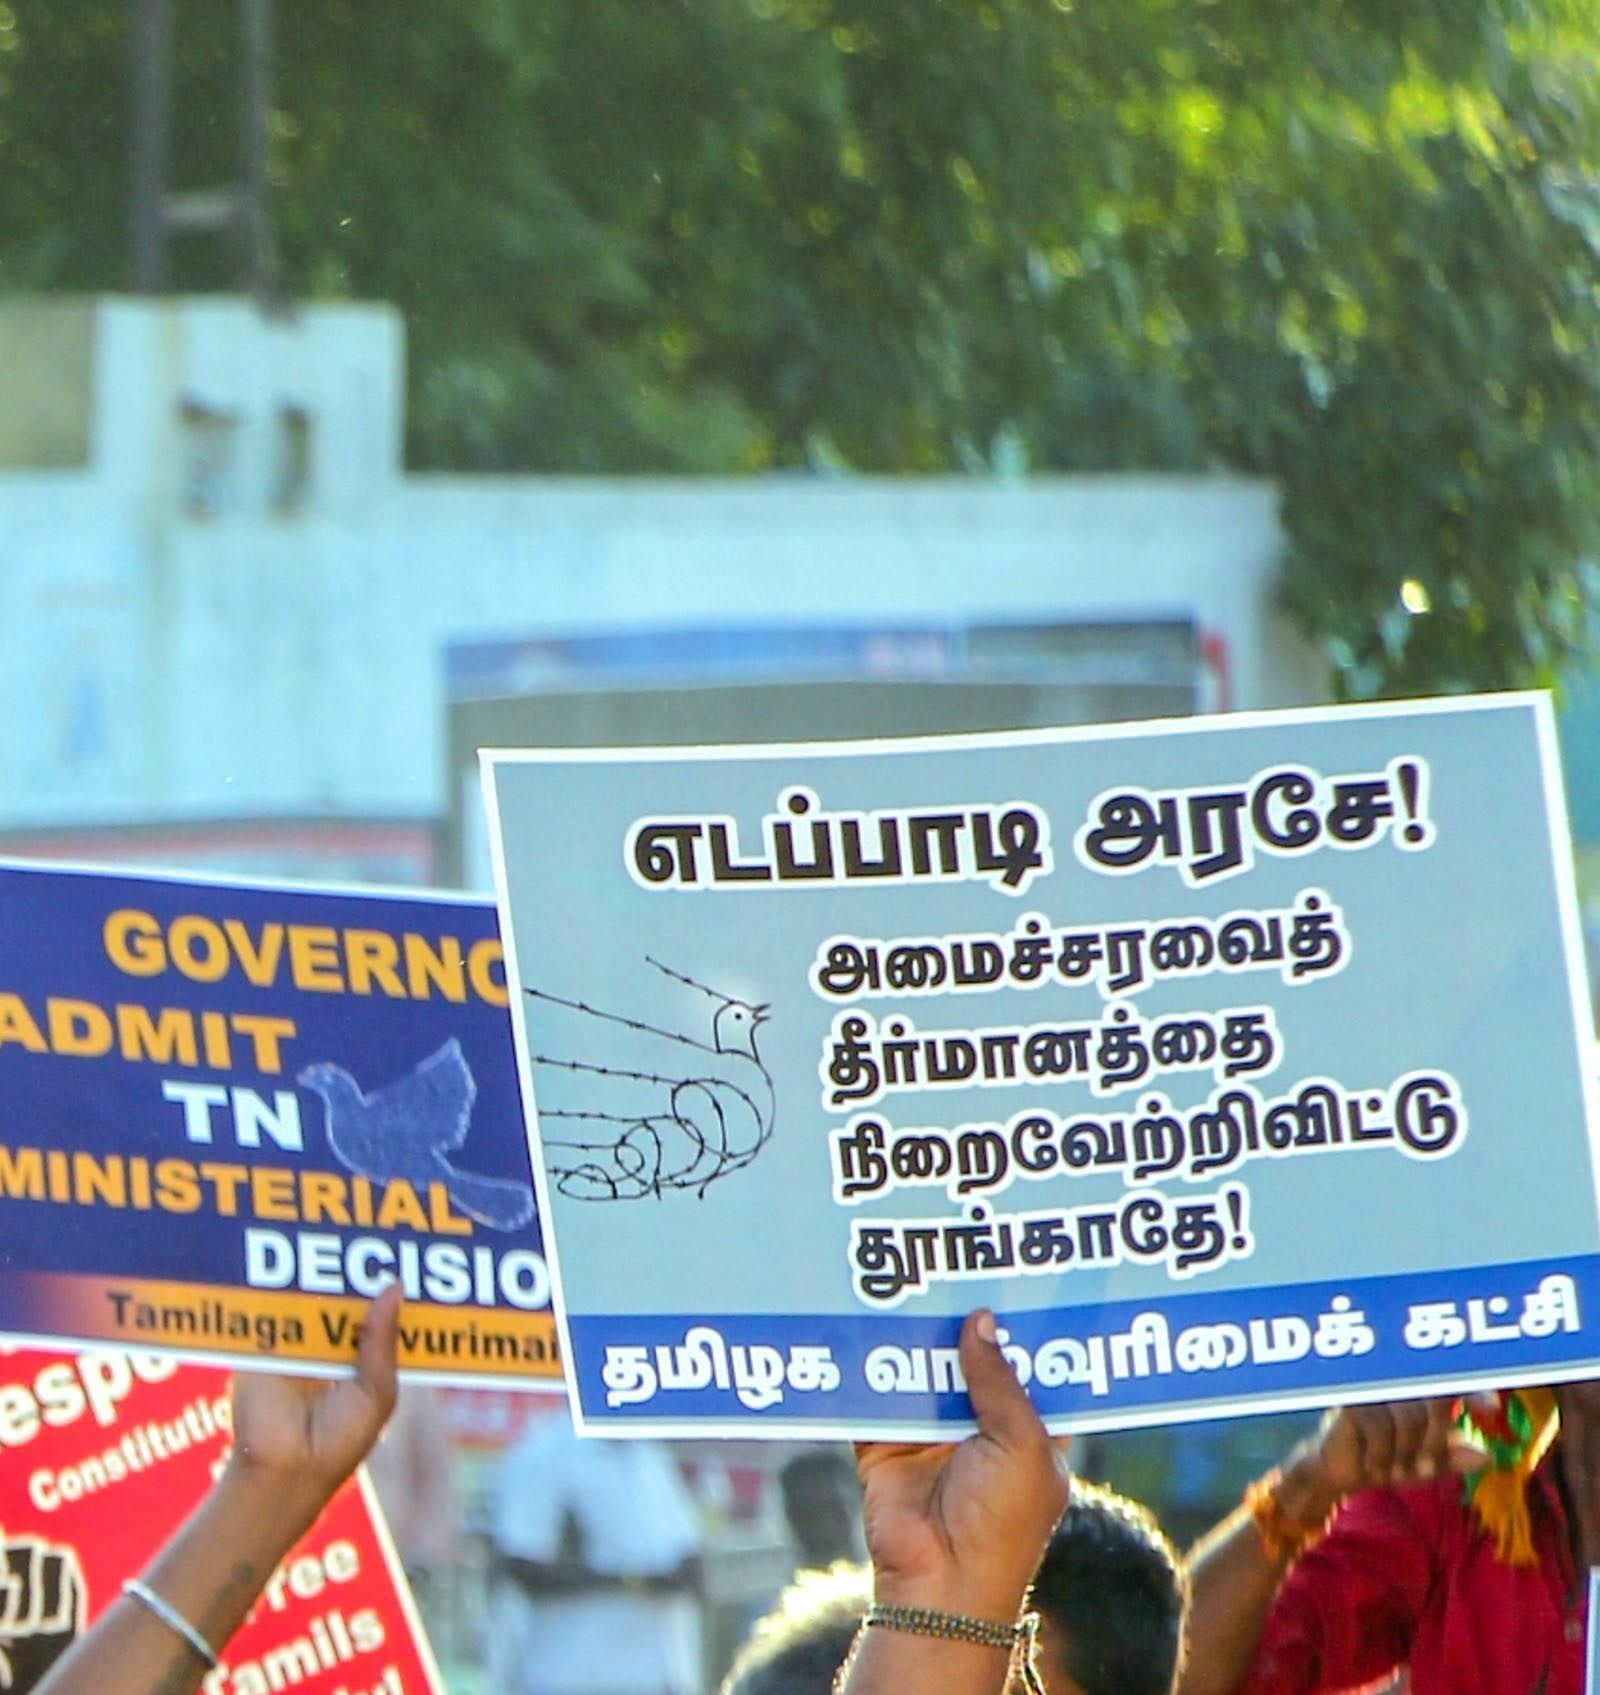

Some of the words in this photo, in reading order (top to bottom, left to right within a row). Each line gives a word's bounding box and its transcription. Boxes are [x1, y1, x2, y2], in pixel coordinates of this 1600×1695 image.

[629, 789, 1043, 890] எடப்பாடி
[1082, 757, 1429, 881] அரசே!
[103, 909, 513, 1008] GOVERNO
[811, 887, 1350, 997] அமைச்சரவைத்
[821, 1000, 1278, 1104] தீர்மானத்தை
[161, 1080, 303, 1151] TN
[834, 1075, 1464, 1200] நிறைவேற்றிவிட்டு
[245, 1228, 550, 1308] DECISIO
[849, 1187, 1254, 1308] தூங்காதே!
[108, 1290, 303, 1350] Tamilaga
[320, 1311, 560, 1364] Vavurimai
[601, 1327, 841, 1410] தமிழக
[1403, 1272, 1581, 1358] கட்சி
[29, 1396, 234, 1512] Constitutio
